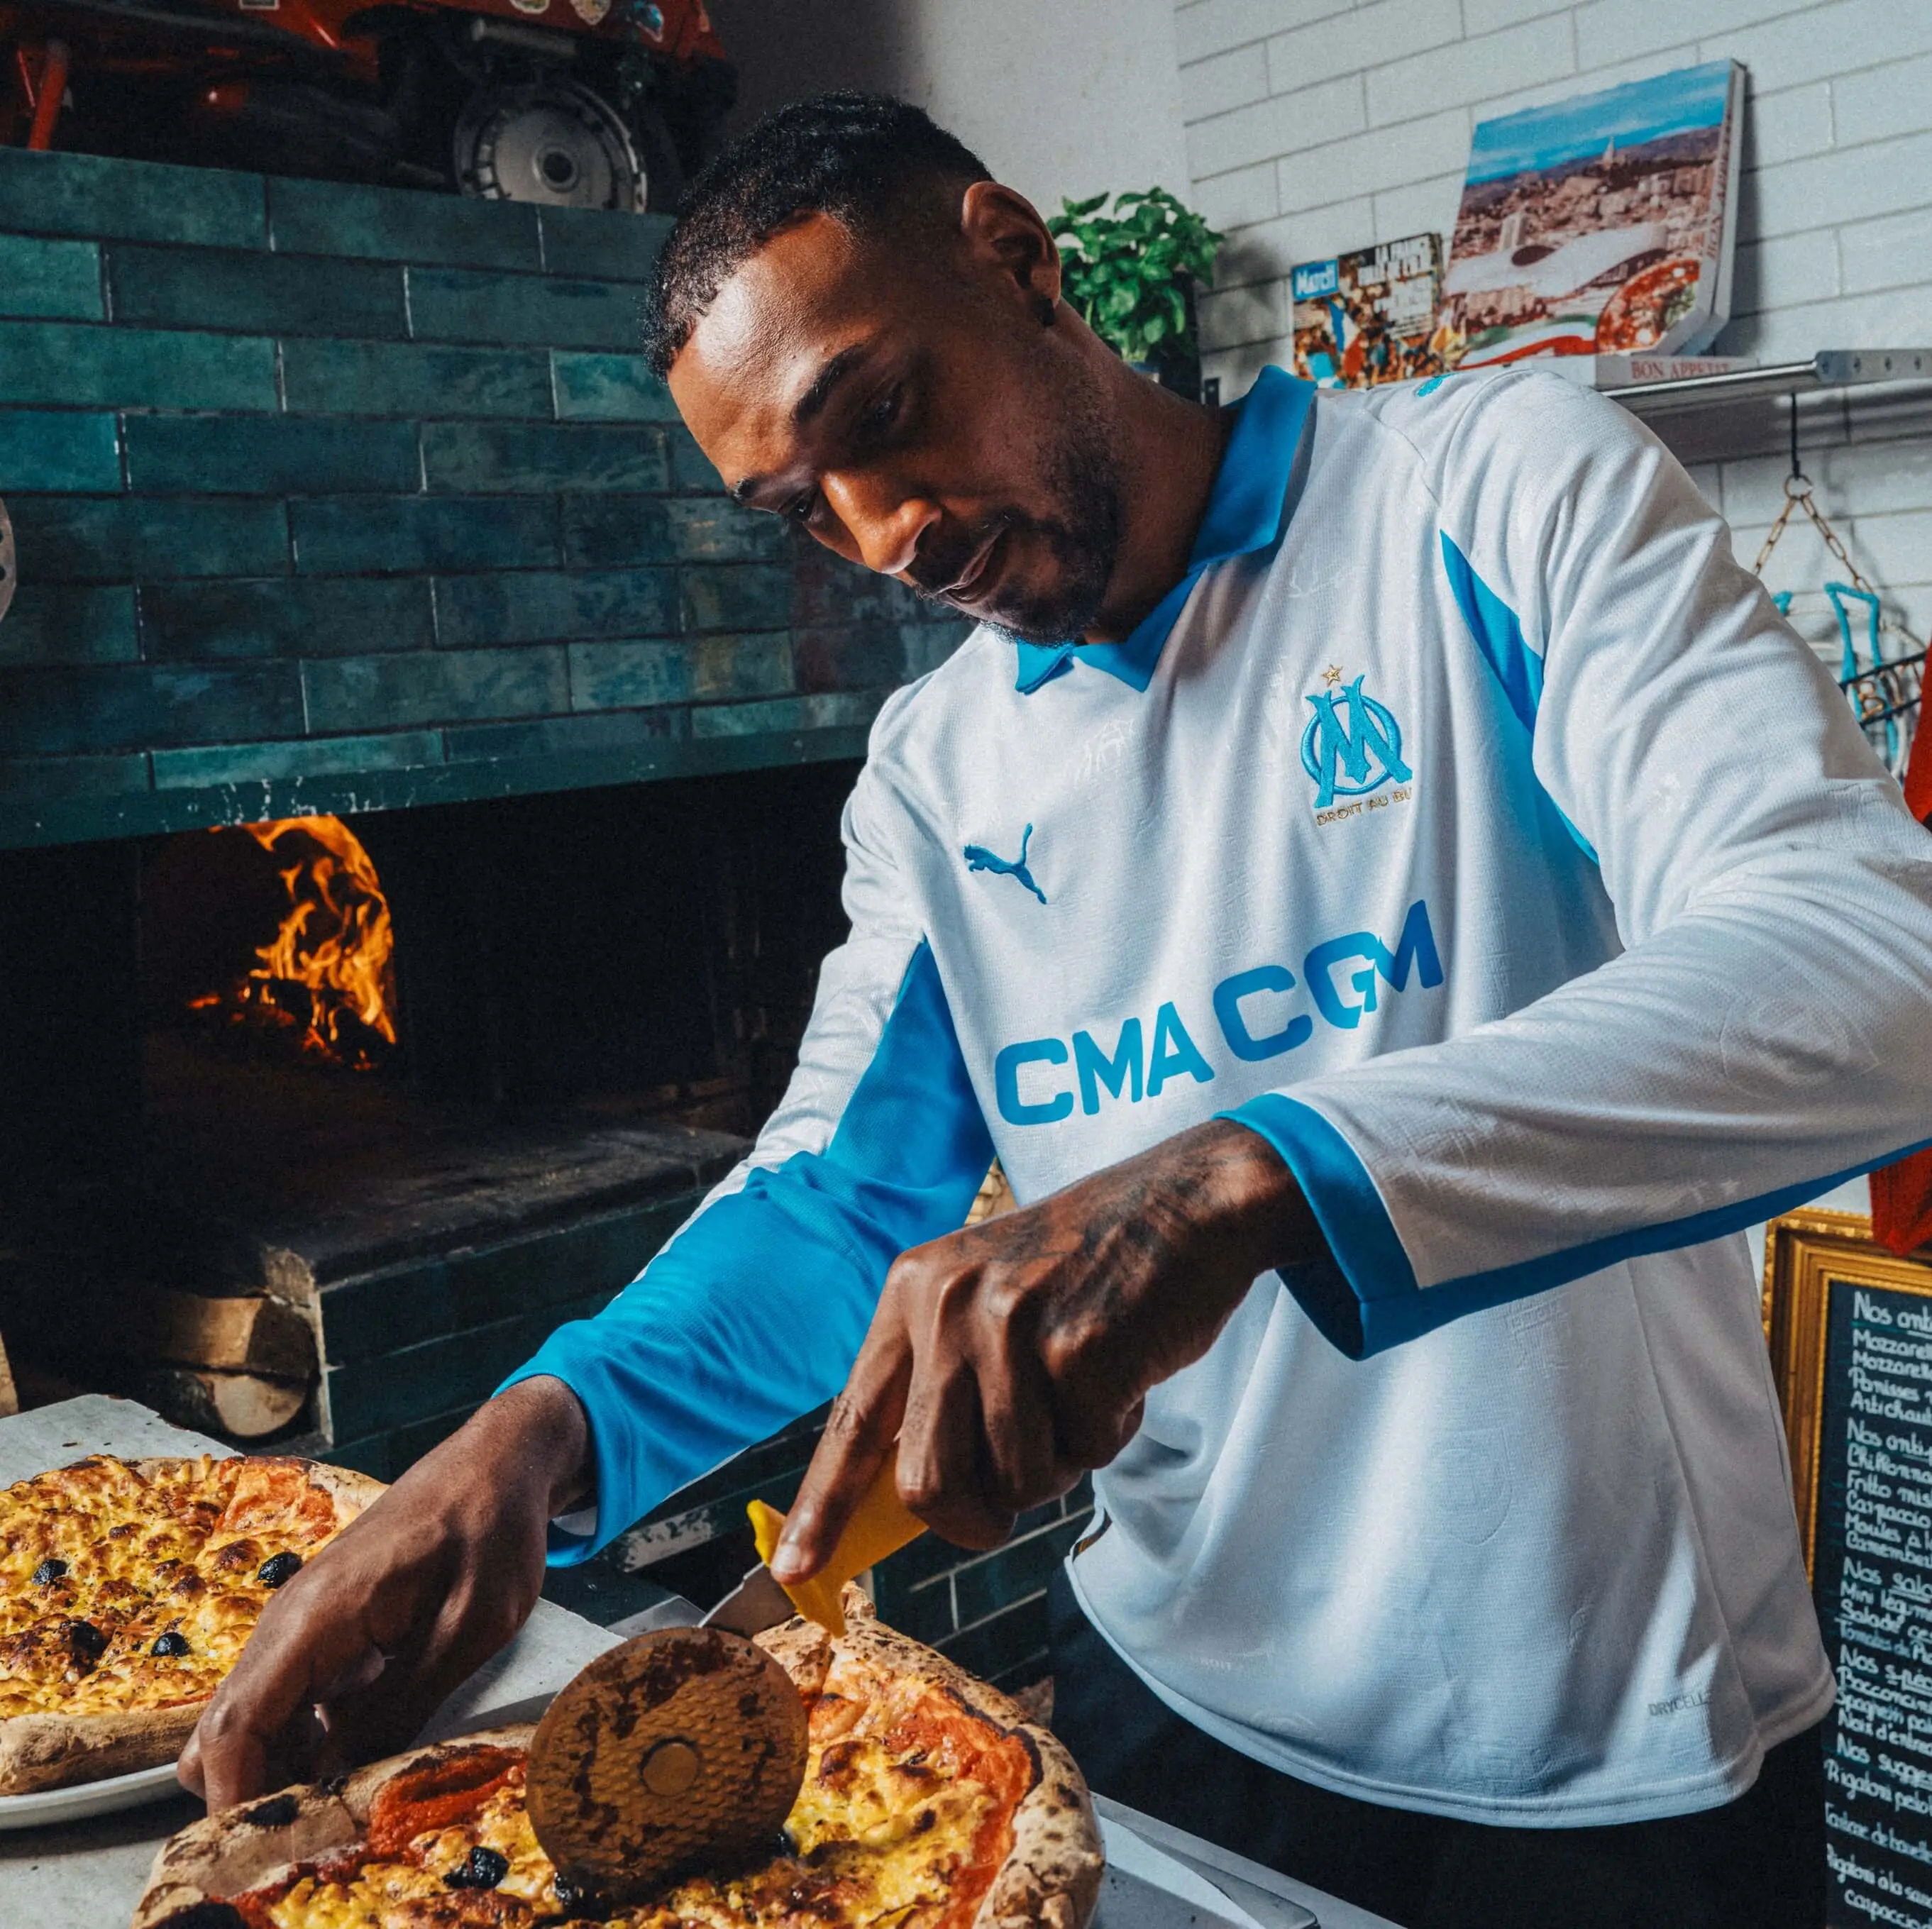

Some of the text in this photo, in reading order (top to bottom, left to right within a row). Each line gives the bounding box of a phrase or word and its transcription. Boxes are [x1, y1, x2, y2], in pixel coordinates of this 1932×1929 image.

[1631, 360, 1664, 380] BON
[1316, 787, 1412, 826] DROIT AU BU
[995, 900, 1443, 1126] CMA CGM
[1854, 1290, 1893, 1325] Nos
[1847, 1417, 1882, 1447] Nos
[1846, 1489, 1931, 1529] Carpaccio
[1897, 1486, 1932, 1508] mis
[1843, 1556, 1882, 1585] Nos
[1840, 1644, 1879, 1674] Nos
[1647, 1692, 1710, 1716] DRYCELL
[1836, 1732, 1871, 1764] Nos
